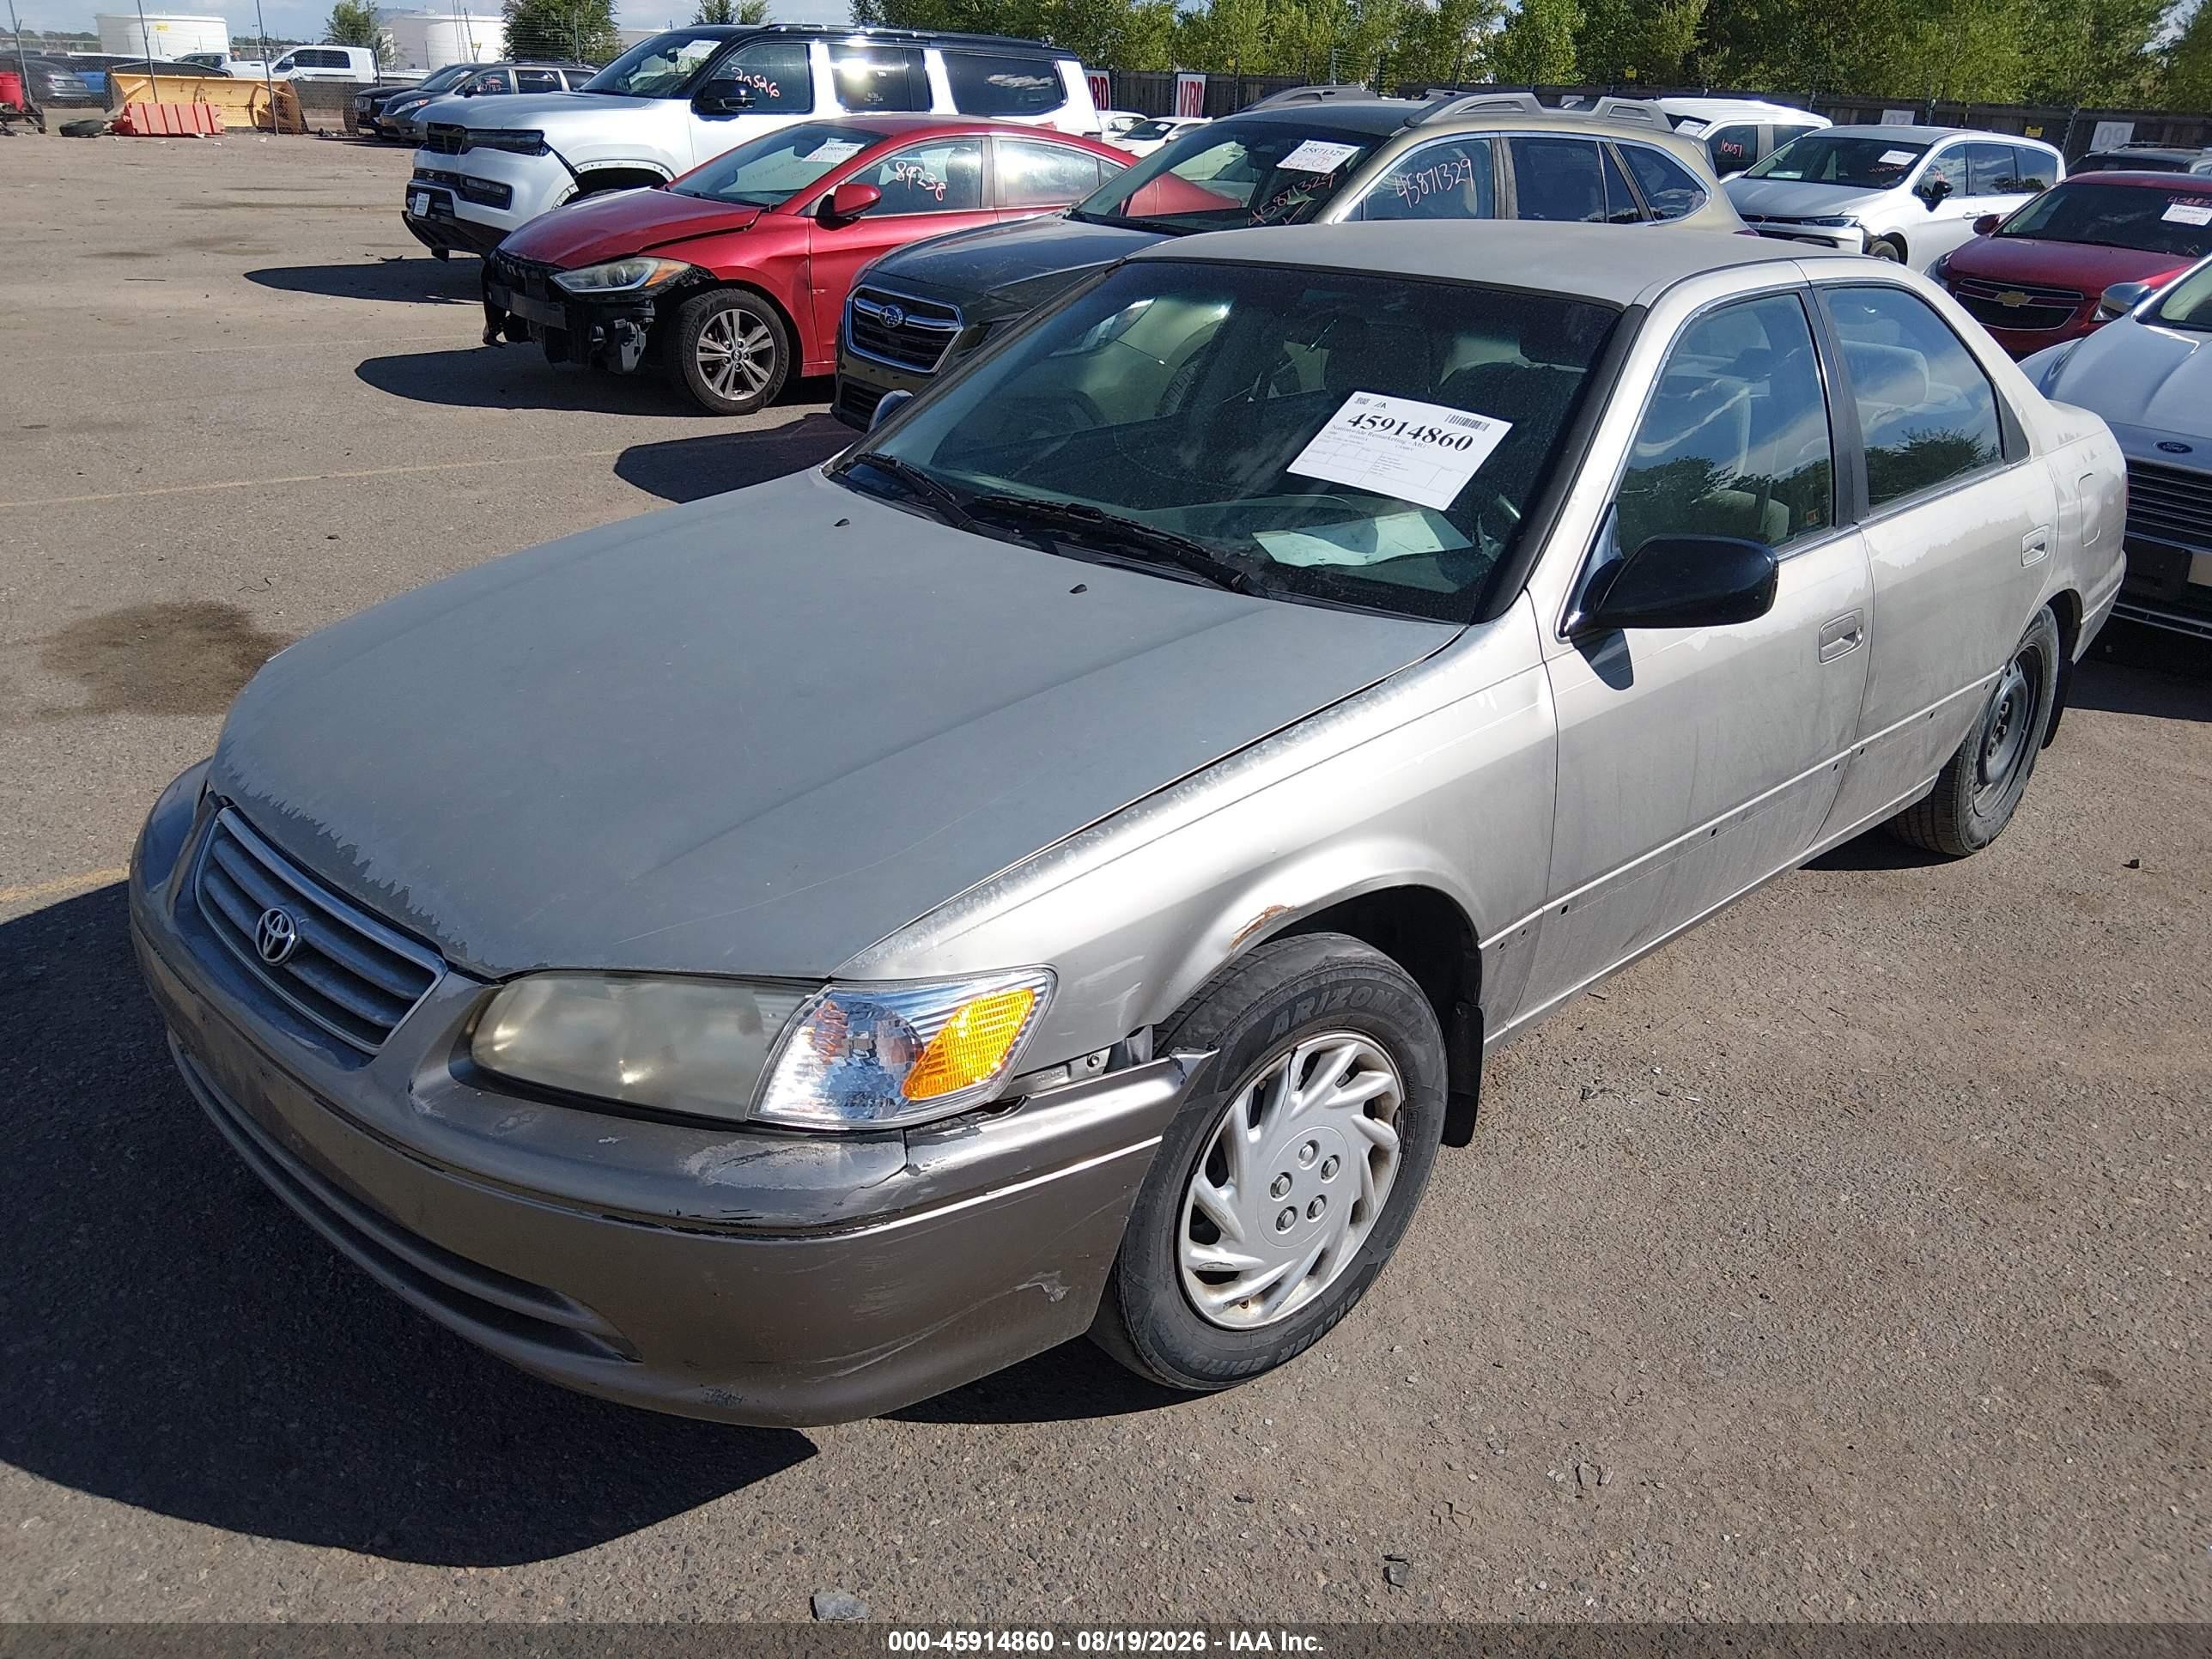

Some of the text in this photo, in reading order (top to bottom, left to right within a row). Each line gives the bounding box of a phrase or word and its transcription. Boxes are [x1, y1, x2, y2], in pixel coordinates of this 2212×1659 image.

[1087, 76, 1109, 110] RD
[895, 161, 946, 201] 89238
[1395, 158, 1474, 208] 45871329
[1347, 413, 1474, 452] 45914860
